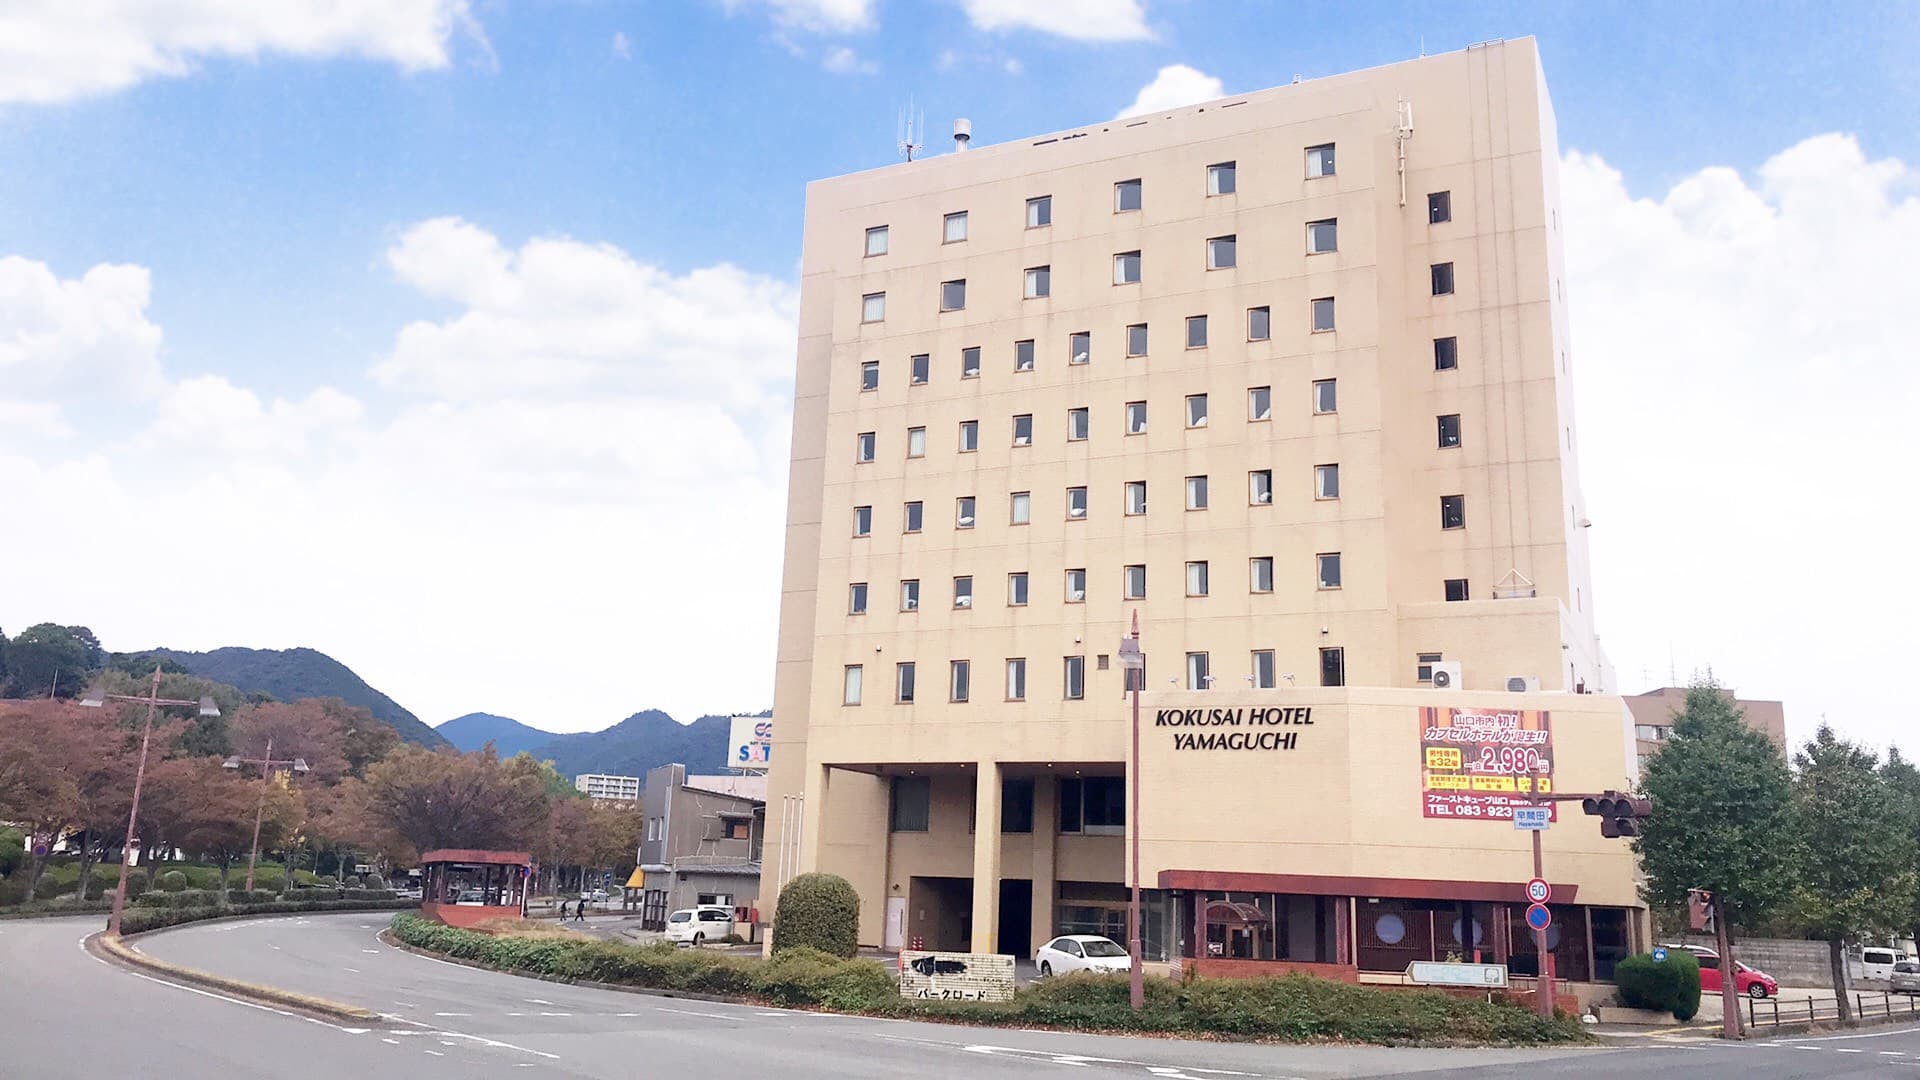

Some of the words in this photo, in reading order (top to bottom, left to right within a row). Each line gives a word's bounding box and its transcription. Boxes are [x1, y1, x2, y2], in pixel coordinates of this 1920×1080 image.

[1155, 708, 1243, 727] KOKUSAI
[1248, 707, 1315, 725] HOTEL
[1173, 732, 1298, 750] YAMAGUCHI
[1428, 804, 1453, 815] TEL
[1532, 885, 1545, 896] 50
[917, 987, 987, 1000] パークロード
